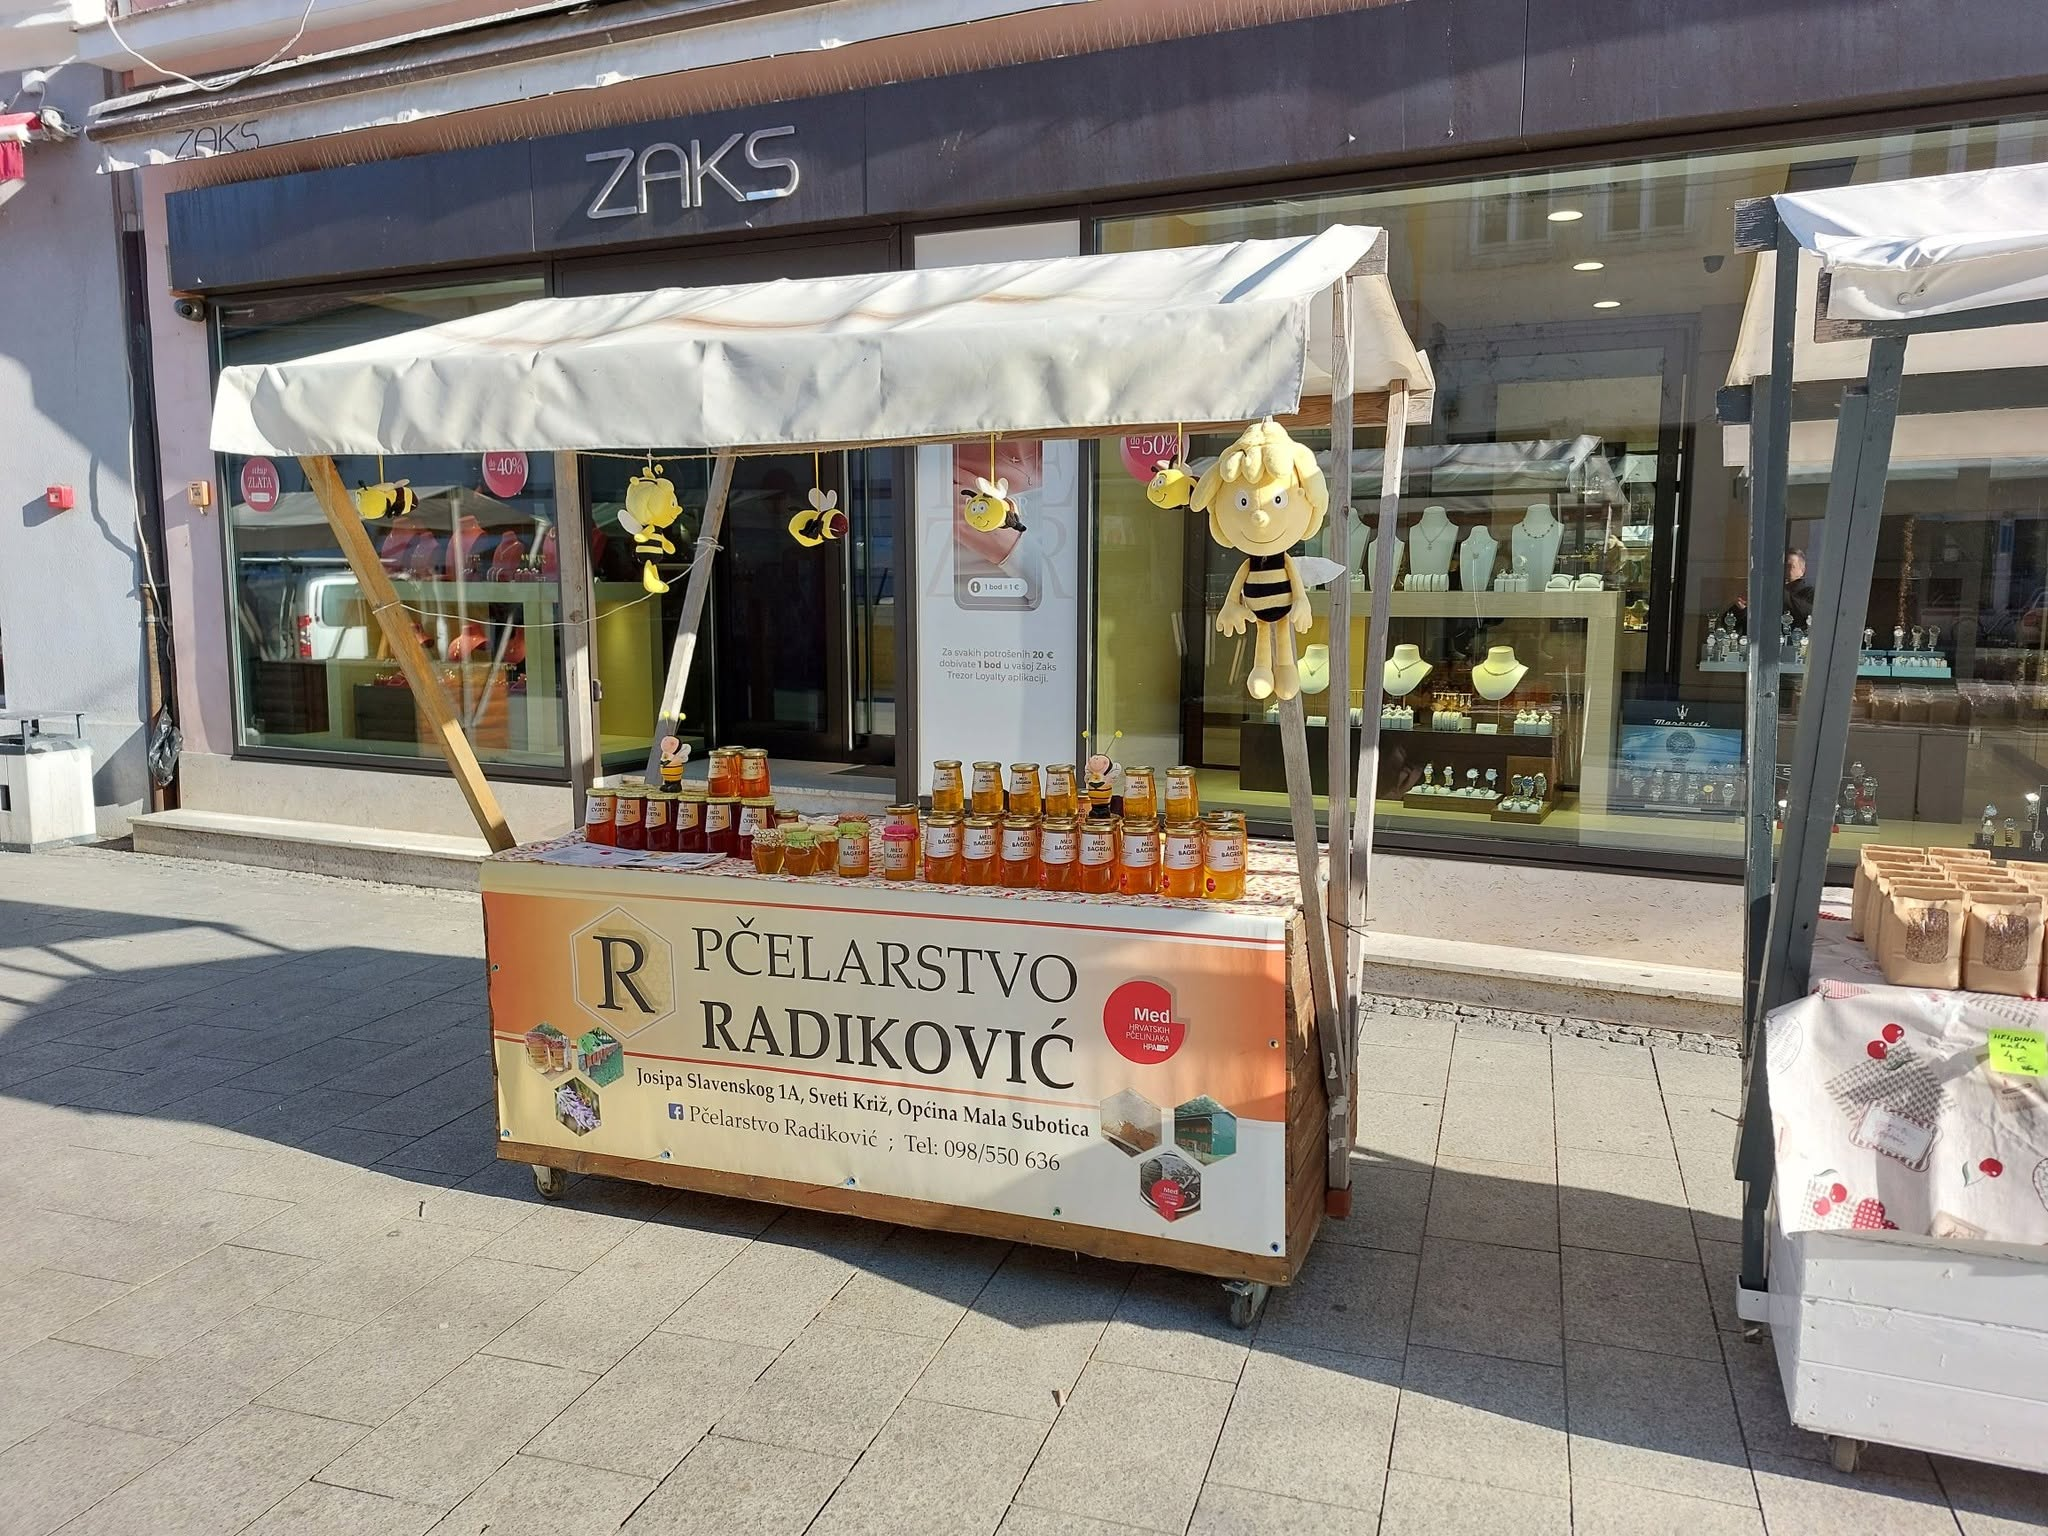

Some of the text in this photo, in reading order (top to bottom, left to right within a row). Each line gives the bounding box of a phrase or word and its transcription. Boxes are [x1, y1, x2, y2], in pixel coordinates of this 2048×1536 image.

[175, 119, 259, 160] ZAKS
[585, 125, 800, 219] ZAKS
[1142, 435, 1178, 455] 50%
[497, 457, 523, 475] 40%
[247, 476, 273, 489] ZLATA
[942, 647, 1054, 661] Za svakih potrošenih 20 €
[939, 659, 976, 668] dobivate
[984, 660, 1002, 669] bod
[1011, 662, 1034, 672] vašoj
[1036, 662, 1057, 671] Zaks
[947, 671, 1049, 684] Trezor Loyalty aplikaciji.
[1653, 718, 1711, 728] Maserati
[691, 916, 1078, 1003] PČELARSTVO
[592, 935, 656, 1015] R
[1134, 1007, 1170, 1024] Med
[1125, 1030, 1170, 1043] PČELINJAKA
[1128, 1023, 1170, 1034] HRVATSKIH
[699, 1000, 1075, 1090] RADIKOVIĆ
[636, 1067, 1090, 1137] Josipa Slavenskog 1A, Sveti Križ, Općina Mala Subotica
[689, 1105, 779, 1134] Pčelarstvo
[784, 1118, 878, 1148] Radiković
[888, 1137, 893, 1152] ;
[904, 1134, 938, 1156] Tel:
[944, 1140, 1019, 1166] 098/550
[1025, 1151, 1060, 1171] 636
